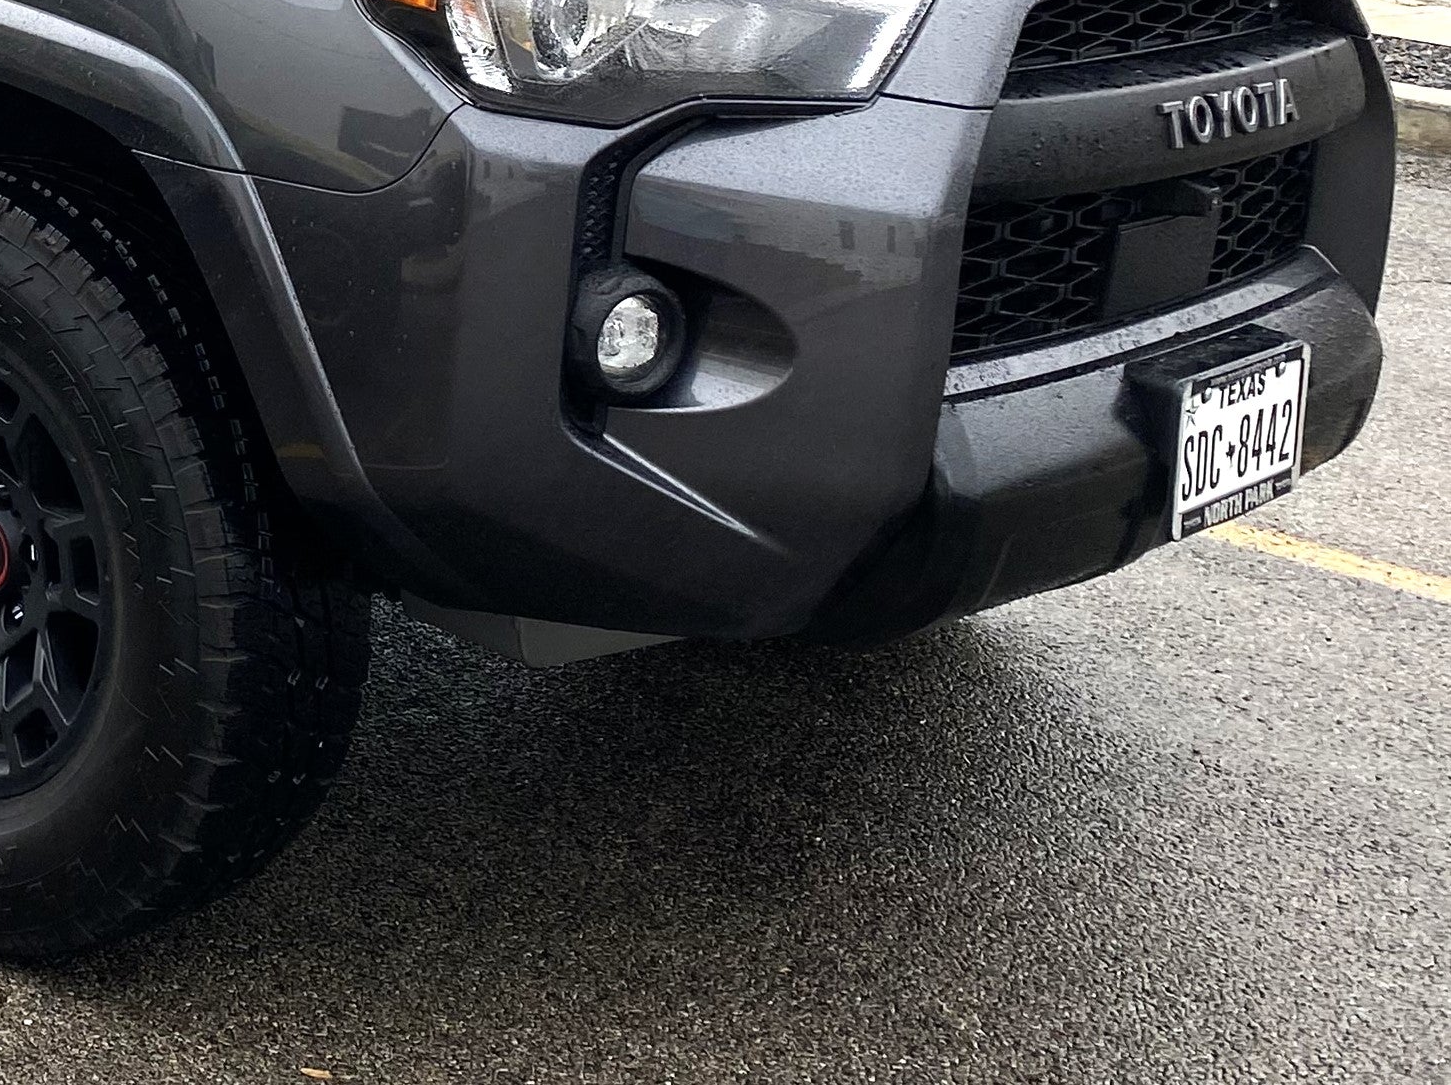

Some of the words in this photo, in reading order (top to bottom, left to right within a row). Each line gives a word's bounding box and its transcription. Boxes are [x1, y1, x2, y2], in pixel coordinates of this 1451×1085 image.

[1157, 78, 1300, 149] TOYOTA
[1219, 372, 1266, 409] TEXAS
[1203, 492, 1243, 528] NORTH
